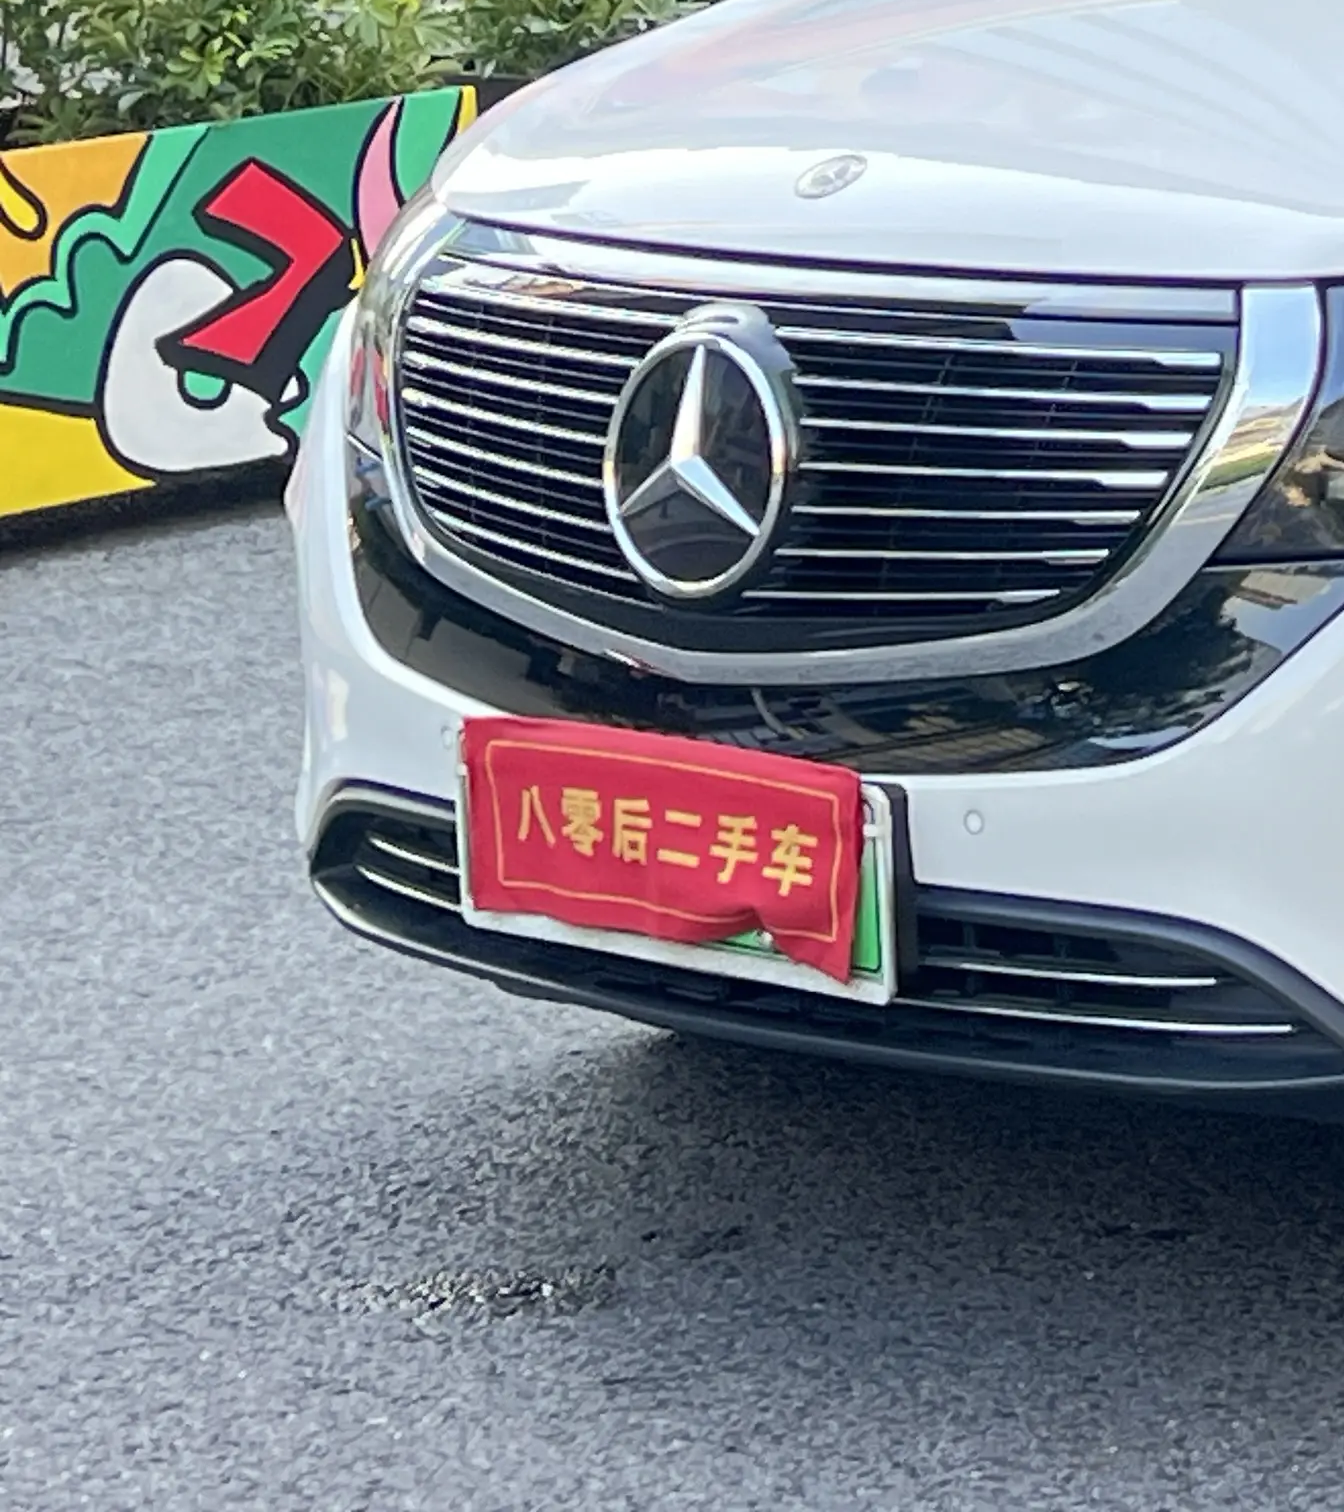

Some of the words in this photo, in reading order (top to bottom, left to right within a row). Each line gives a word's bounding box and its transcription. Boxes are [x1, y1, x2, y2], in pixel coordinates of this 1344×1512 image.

[517, 784, 818, 897] 八零后二手车
